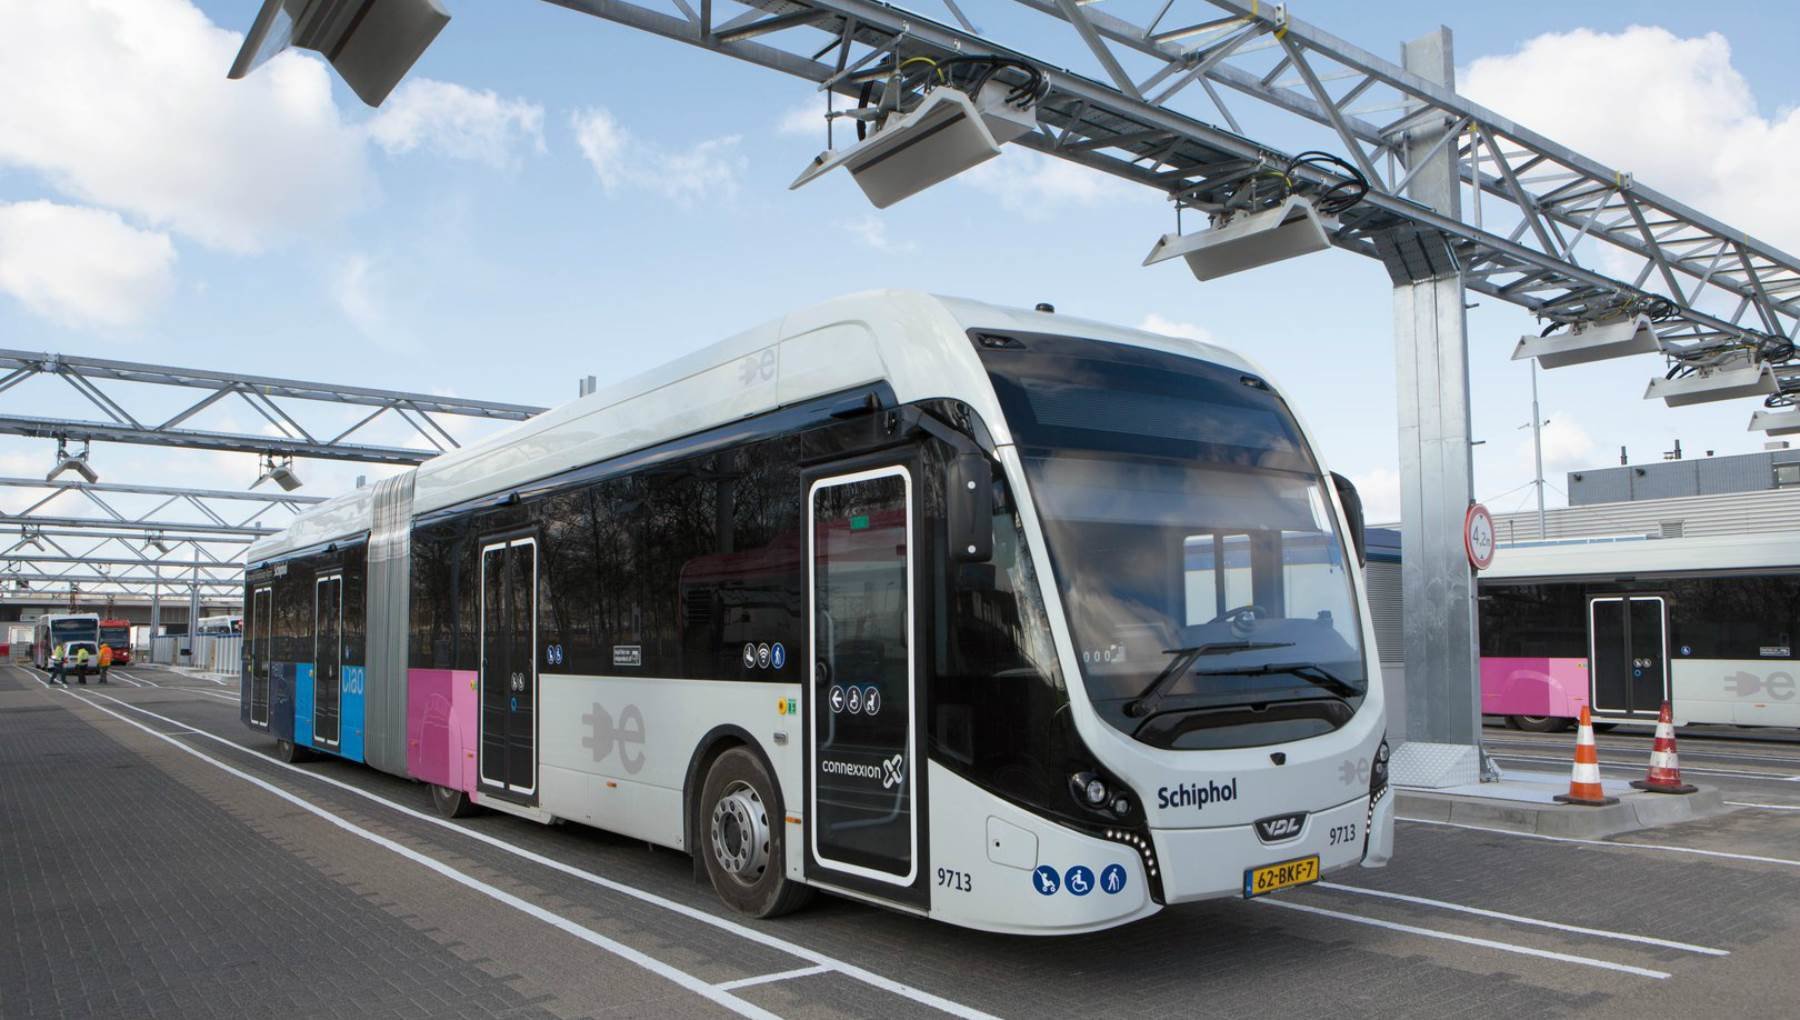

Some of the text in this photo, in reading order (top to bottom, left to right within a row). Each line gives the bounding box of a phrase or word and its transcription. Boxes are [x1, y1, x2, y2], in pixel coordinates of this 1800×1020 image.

[822, 760, 881, 779] connexxion
[1158, 777, 1237, 810] Schiphol
[1263, 818, 1300, 836] VDL
[1329, 824, 1356, 846] 9713
[938, 867, 972, 892] 9713
[1258, 861, 1314, 889] 62-BKF-7
